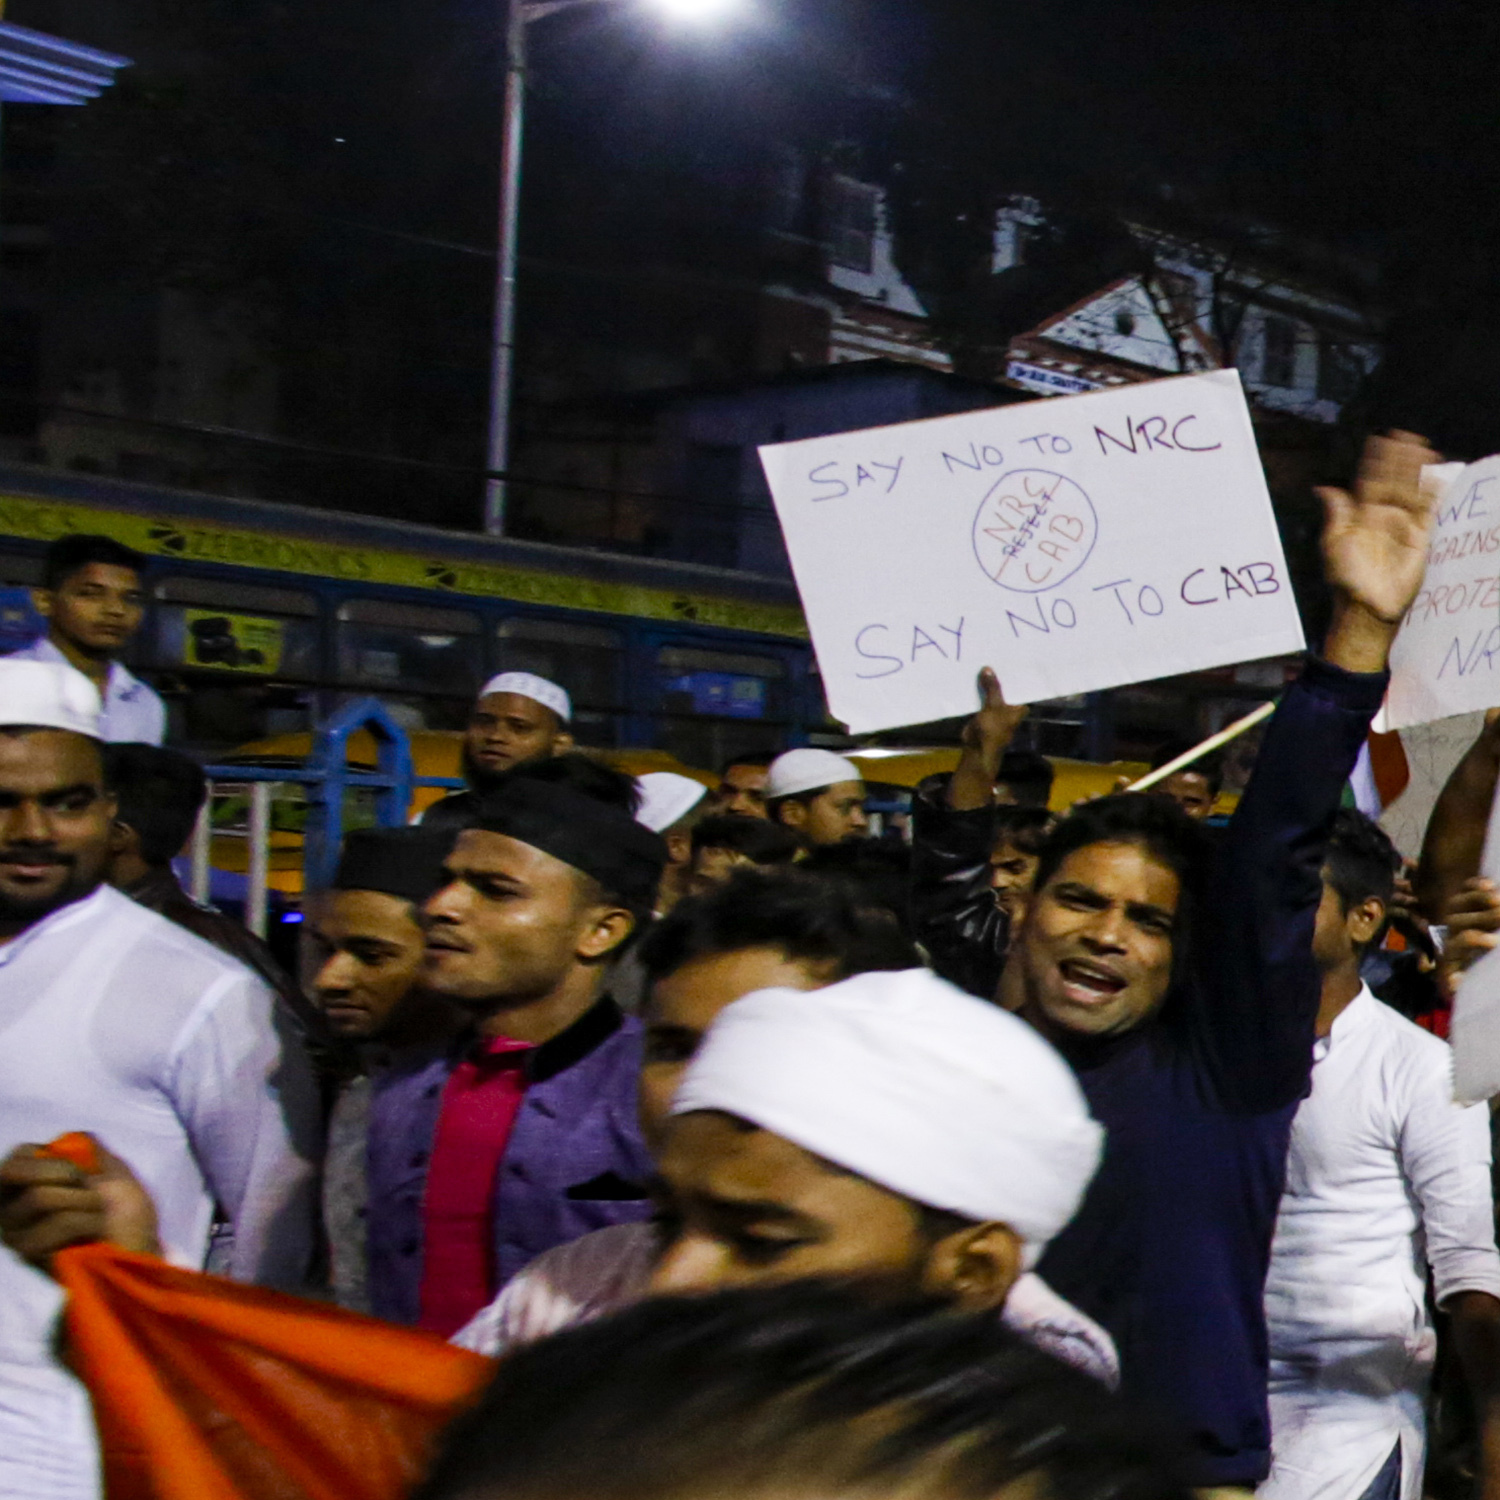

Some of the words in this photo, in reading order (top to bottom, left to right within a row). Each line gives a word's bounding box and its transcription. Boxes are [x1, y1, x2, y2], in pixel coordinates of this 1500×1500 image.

[808, 455, 903, 502] SAY
[941, 442, 1004, 475] NO
[1018, 433, 1073, 456] TO
[1093, 413, 1222, 456] NRC
[982, 475, 1046, 546] NRC
[1001, 490, 1054, 559] REJECT
[1436, 476, 1497, 528] WE
[1024, 513, 1084, 584] CAB
[854, 615, 967, 680] SAY
[1005, 594, 1078, 638] NO
[1092, 578, 1165, 625] TO
[1179, 560, 1282, 607] CAB
